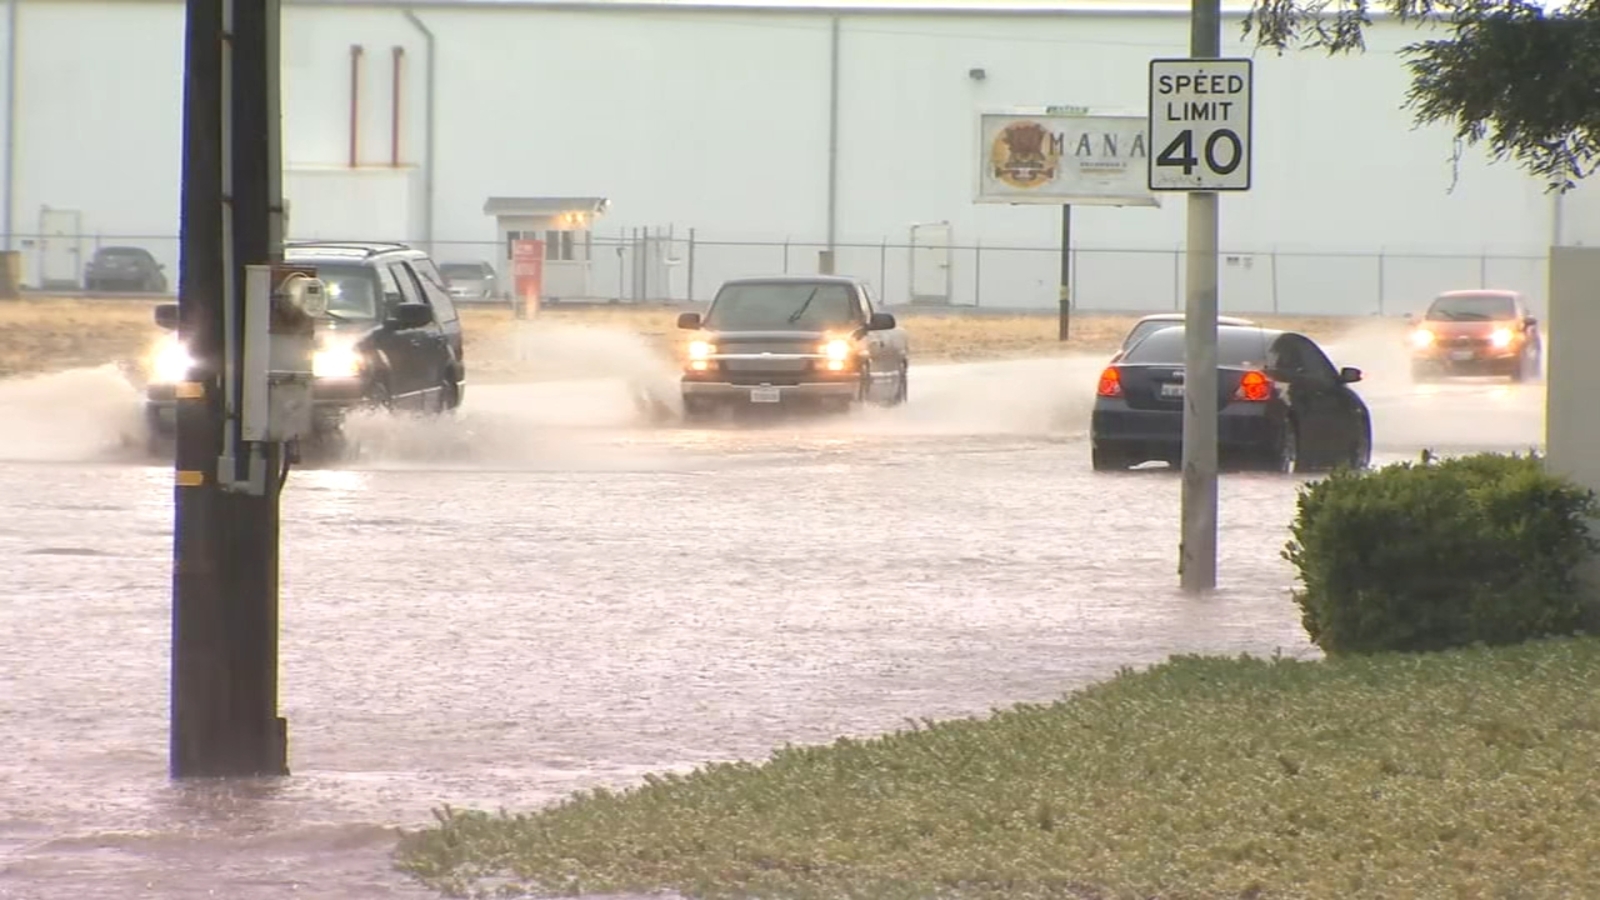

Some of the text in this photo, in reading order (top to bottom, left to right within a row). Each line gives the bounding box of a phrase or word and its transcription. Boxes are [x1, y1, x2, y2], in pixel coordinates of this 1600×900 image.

[1159, 75, 1243, 94] SPEED
[1168, 102, 1233, 121] LIMIT
[1156, 128, 1242, 175] 40
